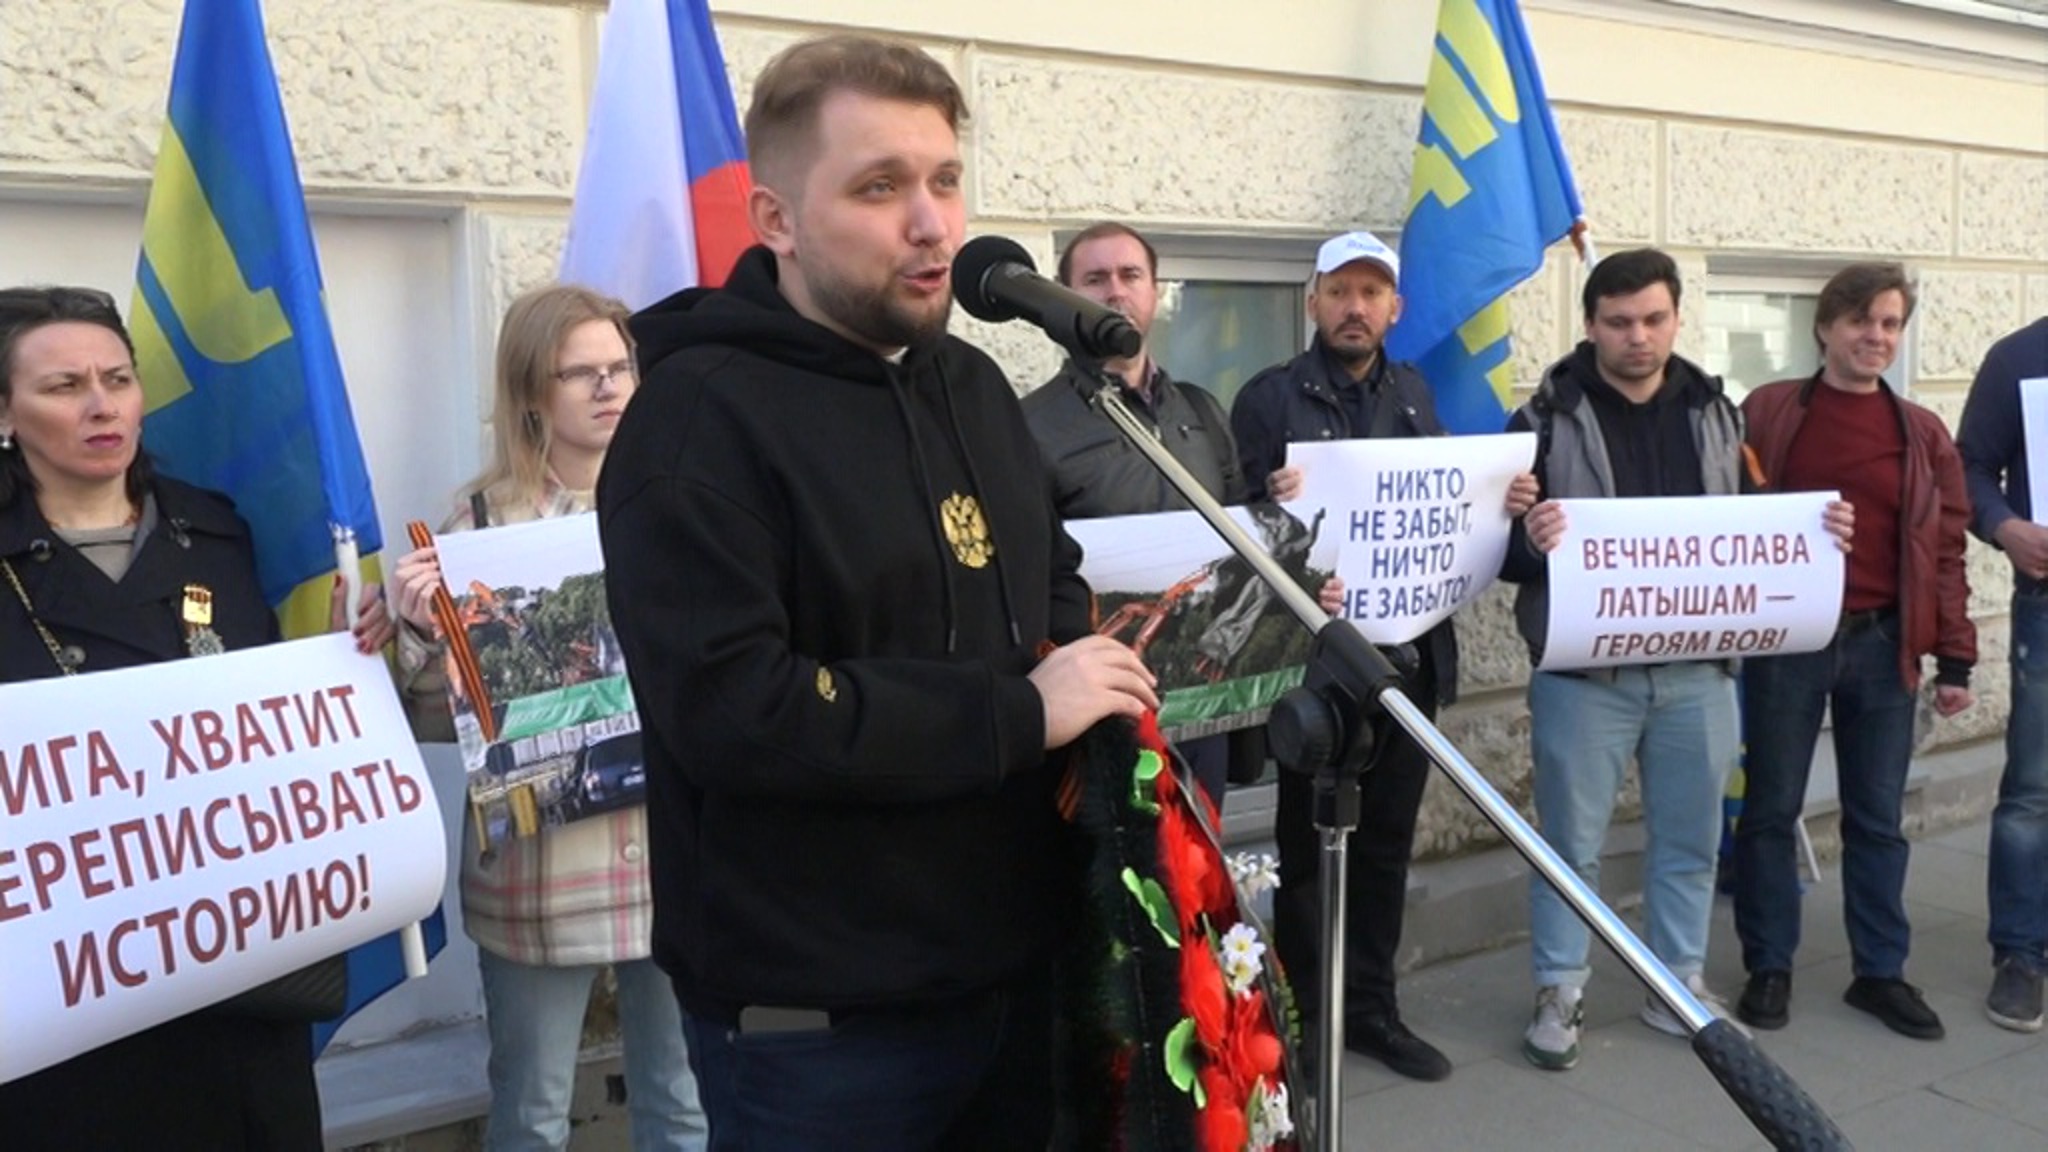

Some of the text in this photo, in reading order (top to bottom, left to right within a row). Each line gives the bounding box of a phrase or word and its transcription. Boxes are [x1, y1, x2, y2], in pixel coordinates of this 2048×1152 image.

[1376, 467, 1465, 502] НИКТО
[1350, 502, 1472, 541] НЕ ЗАБЫТ,
[1371, 543, 1455, 578] НИЧТО
[1582, 533, 1810, 570] ВЕЧНАЯ СЛАВА
[1596, 583, 1757, 618] ЛАТЫШАМ
[1591, 628, 1787, 658] ГЕРОЯМ ВОВ!
[151, 684, 361, 780] ХВАТИТ
[54, 854, 370, 1008] ИСТОРИЮ!
